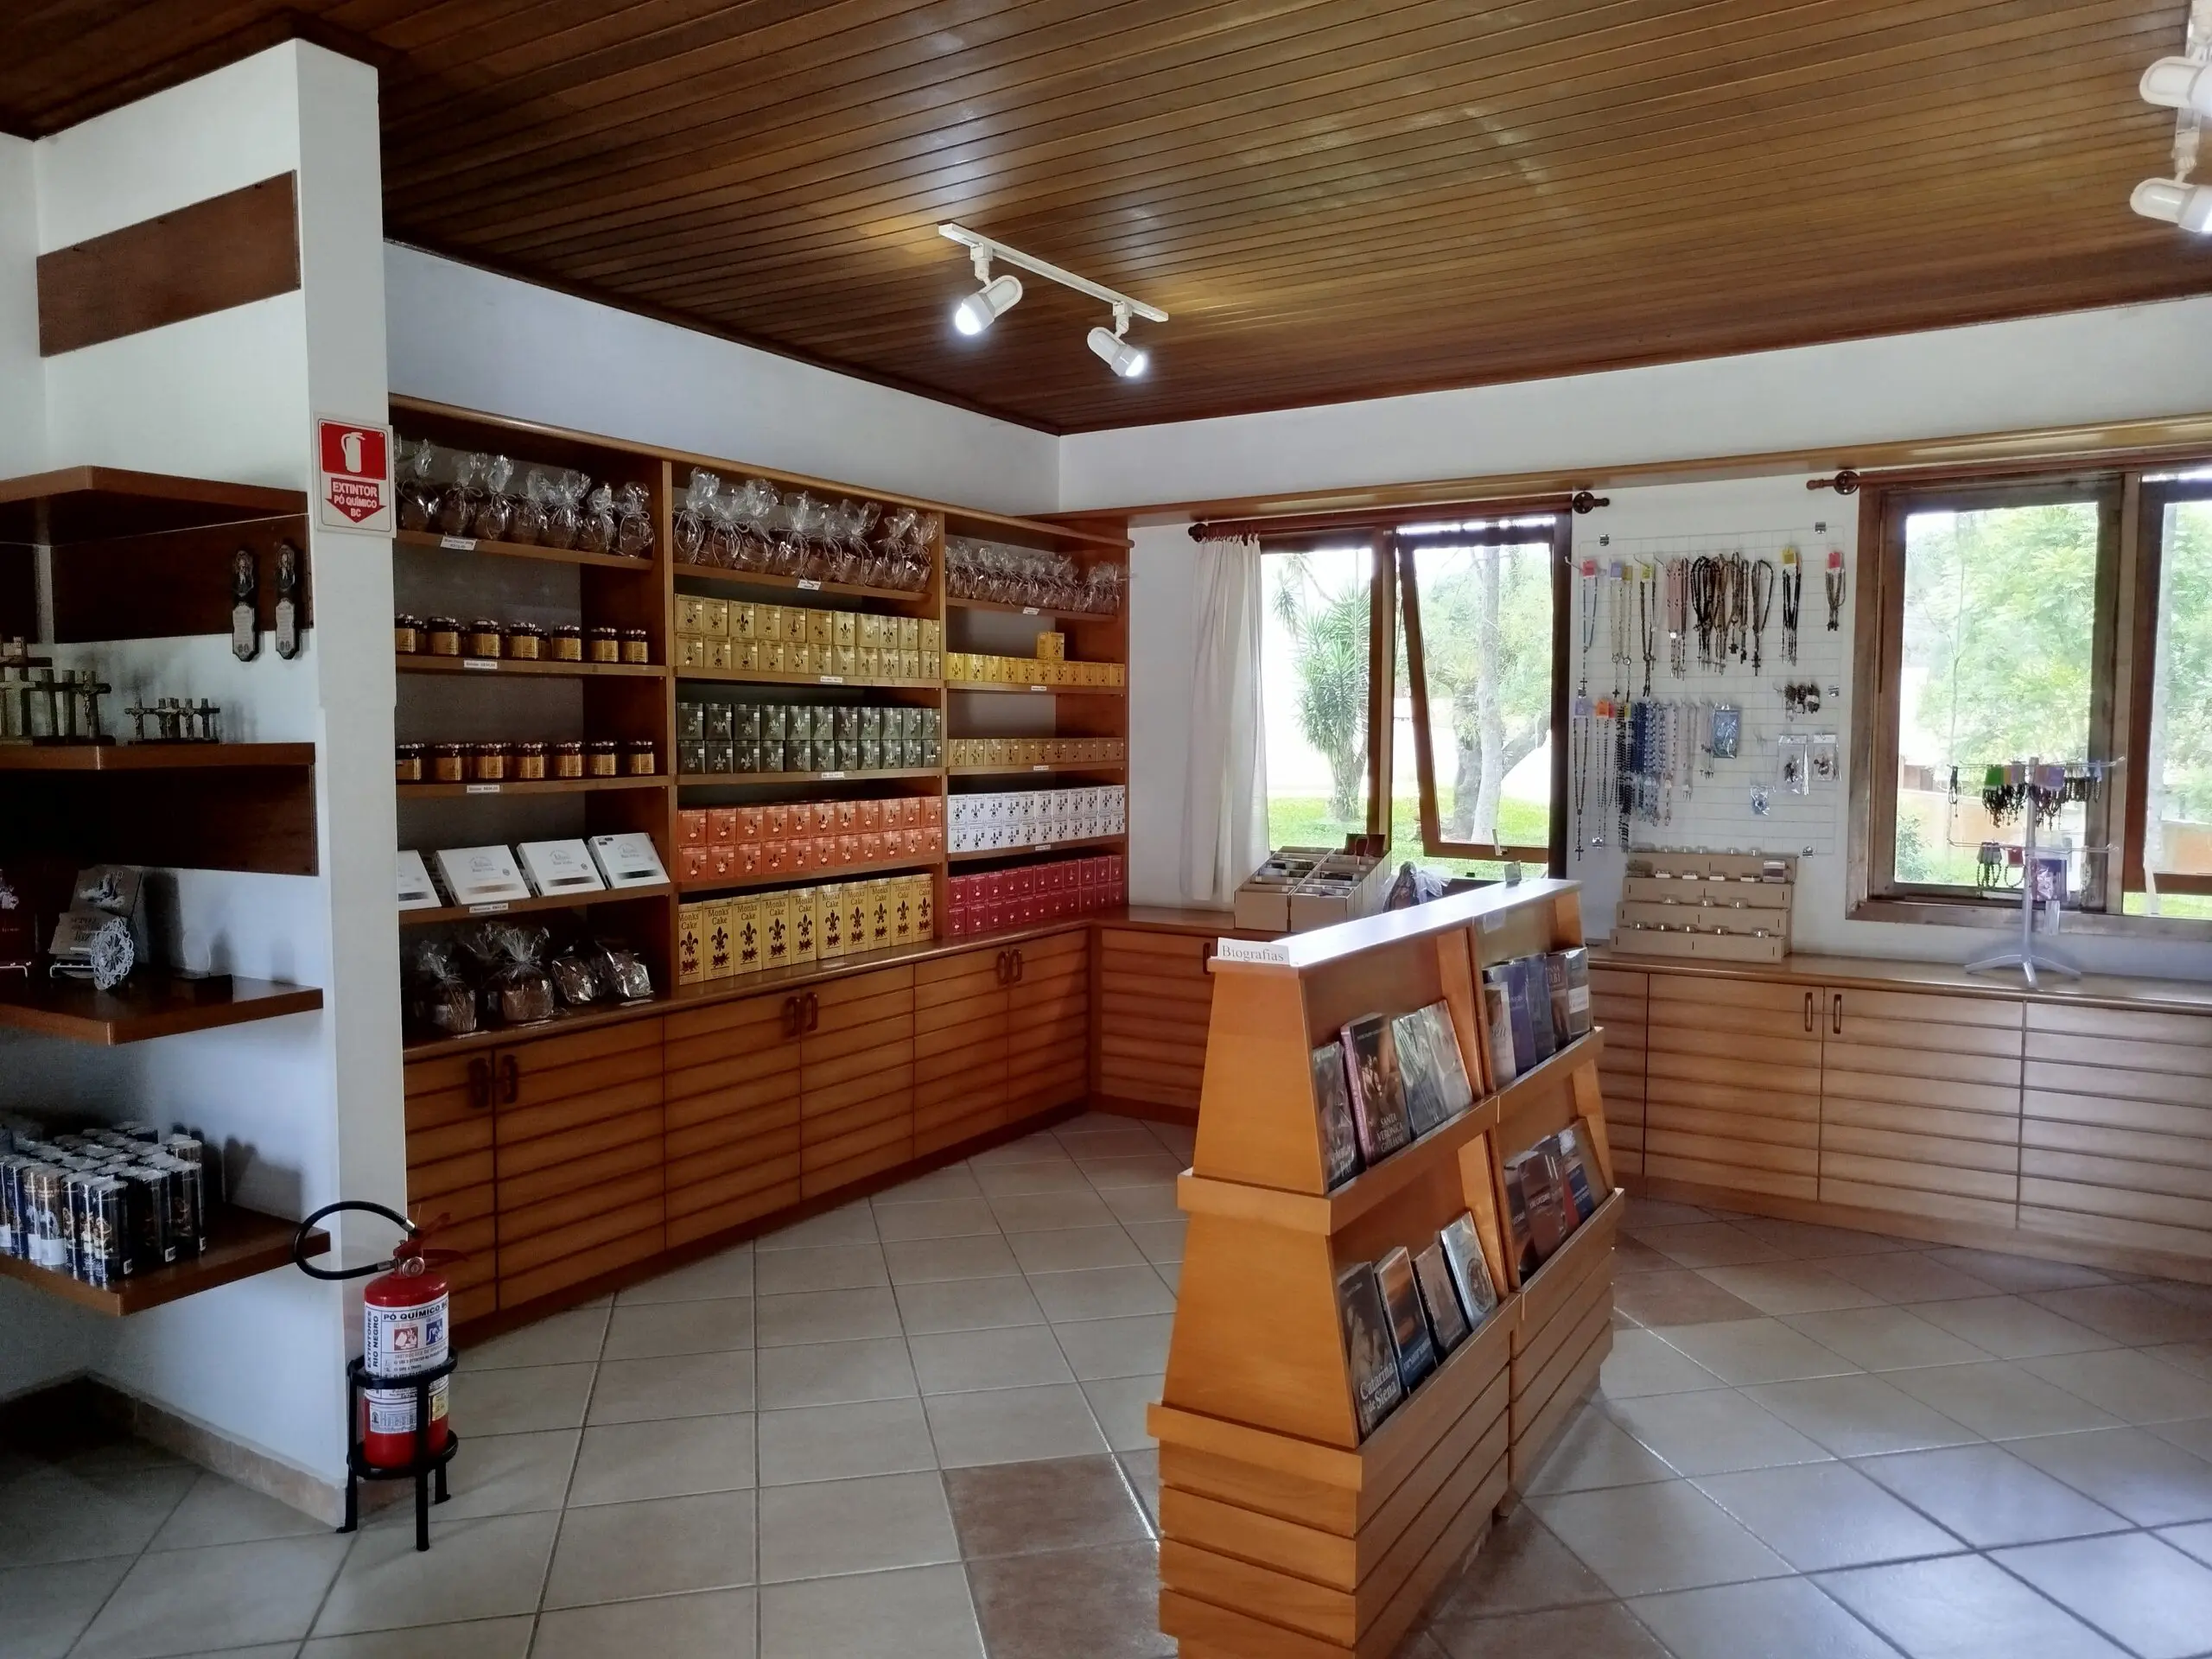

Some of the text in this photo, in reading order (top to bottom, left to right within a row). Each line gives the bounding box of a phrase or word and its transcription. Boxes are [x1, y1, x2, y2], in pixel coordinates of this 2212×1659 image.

[332, 481, 378, 497] EXTINTOR
[334, 494, 378, 509] PÓ QUÍMICO
[874, 893, 887, 902] Cake
[741, 912, 756, 921] Cake
[769, 908, 785, 917] Cake
[712, 917, 728, 925] Cake
[1222, 944, 1284, 962] Biografias
[400, 1305, 441, 1320] QUÍMICO
[1360, 1362, 1395, 1401] Catarina
[1368, 1381, 1396, 1413] de Siena
